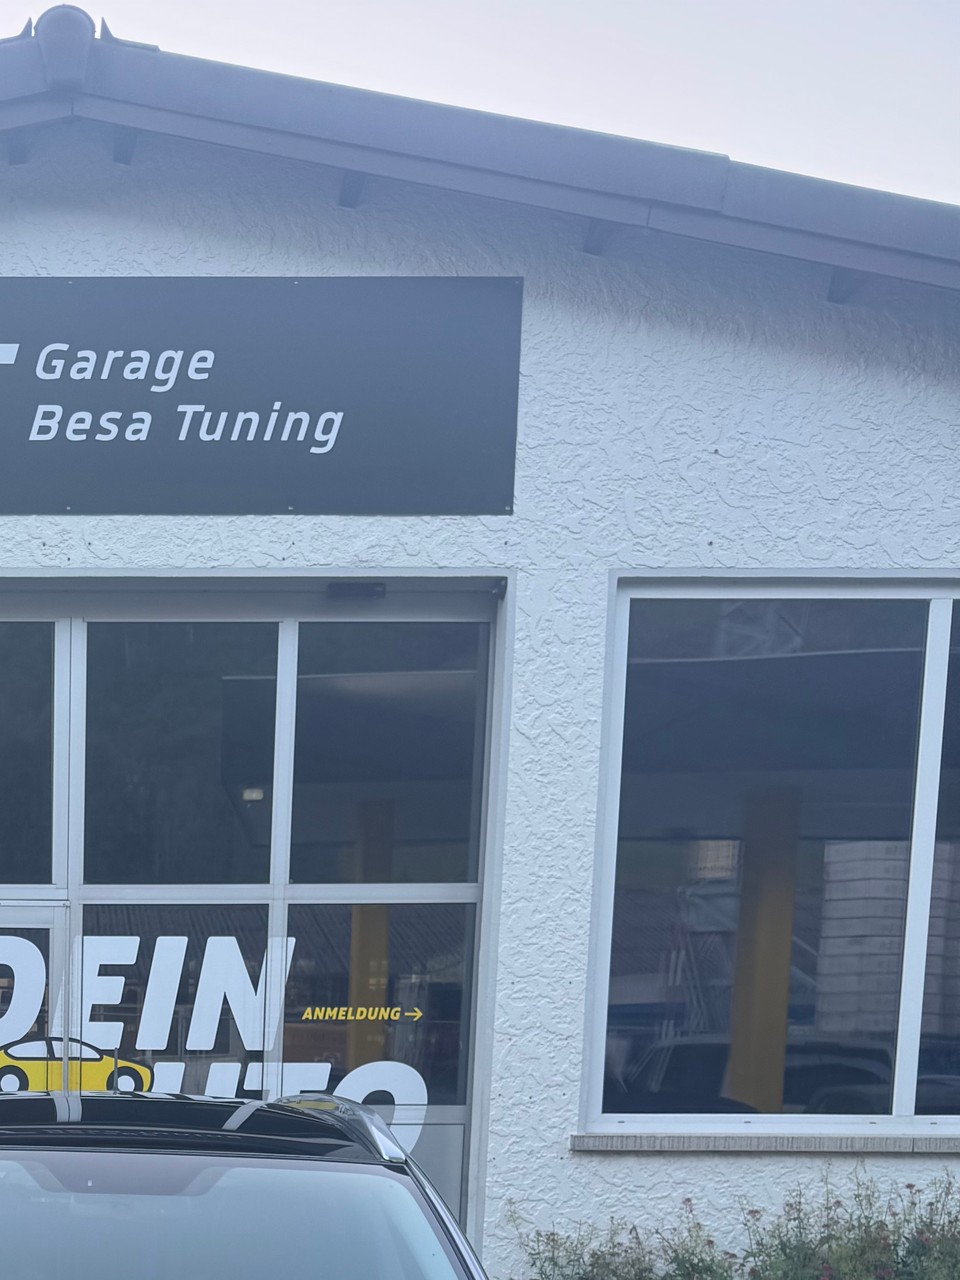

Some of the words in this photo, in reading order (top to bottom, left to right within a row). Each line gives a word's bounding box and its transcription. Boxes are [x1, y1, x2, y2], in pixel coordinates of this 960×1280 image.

[34, 342, 215, 393] Garage
[27, 404, 152, 442] Besa
[176, 402, 345, 454] Tuning
[301, 1006, 402, 1021] ANMELDUNG
